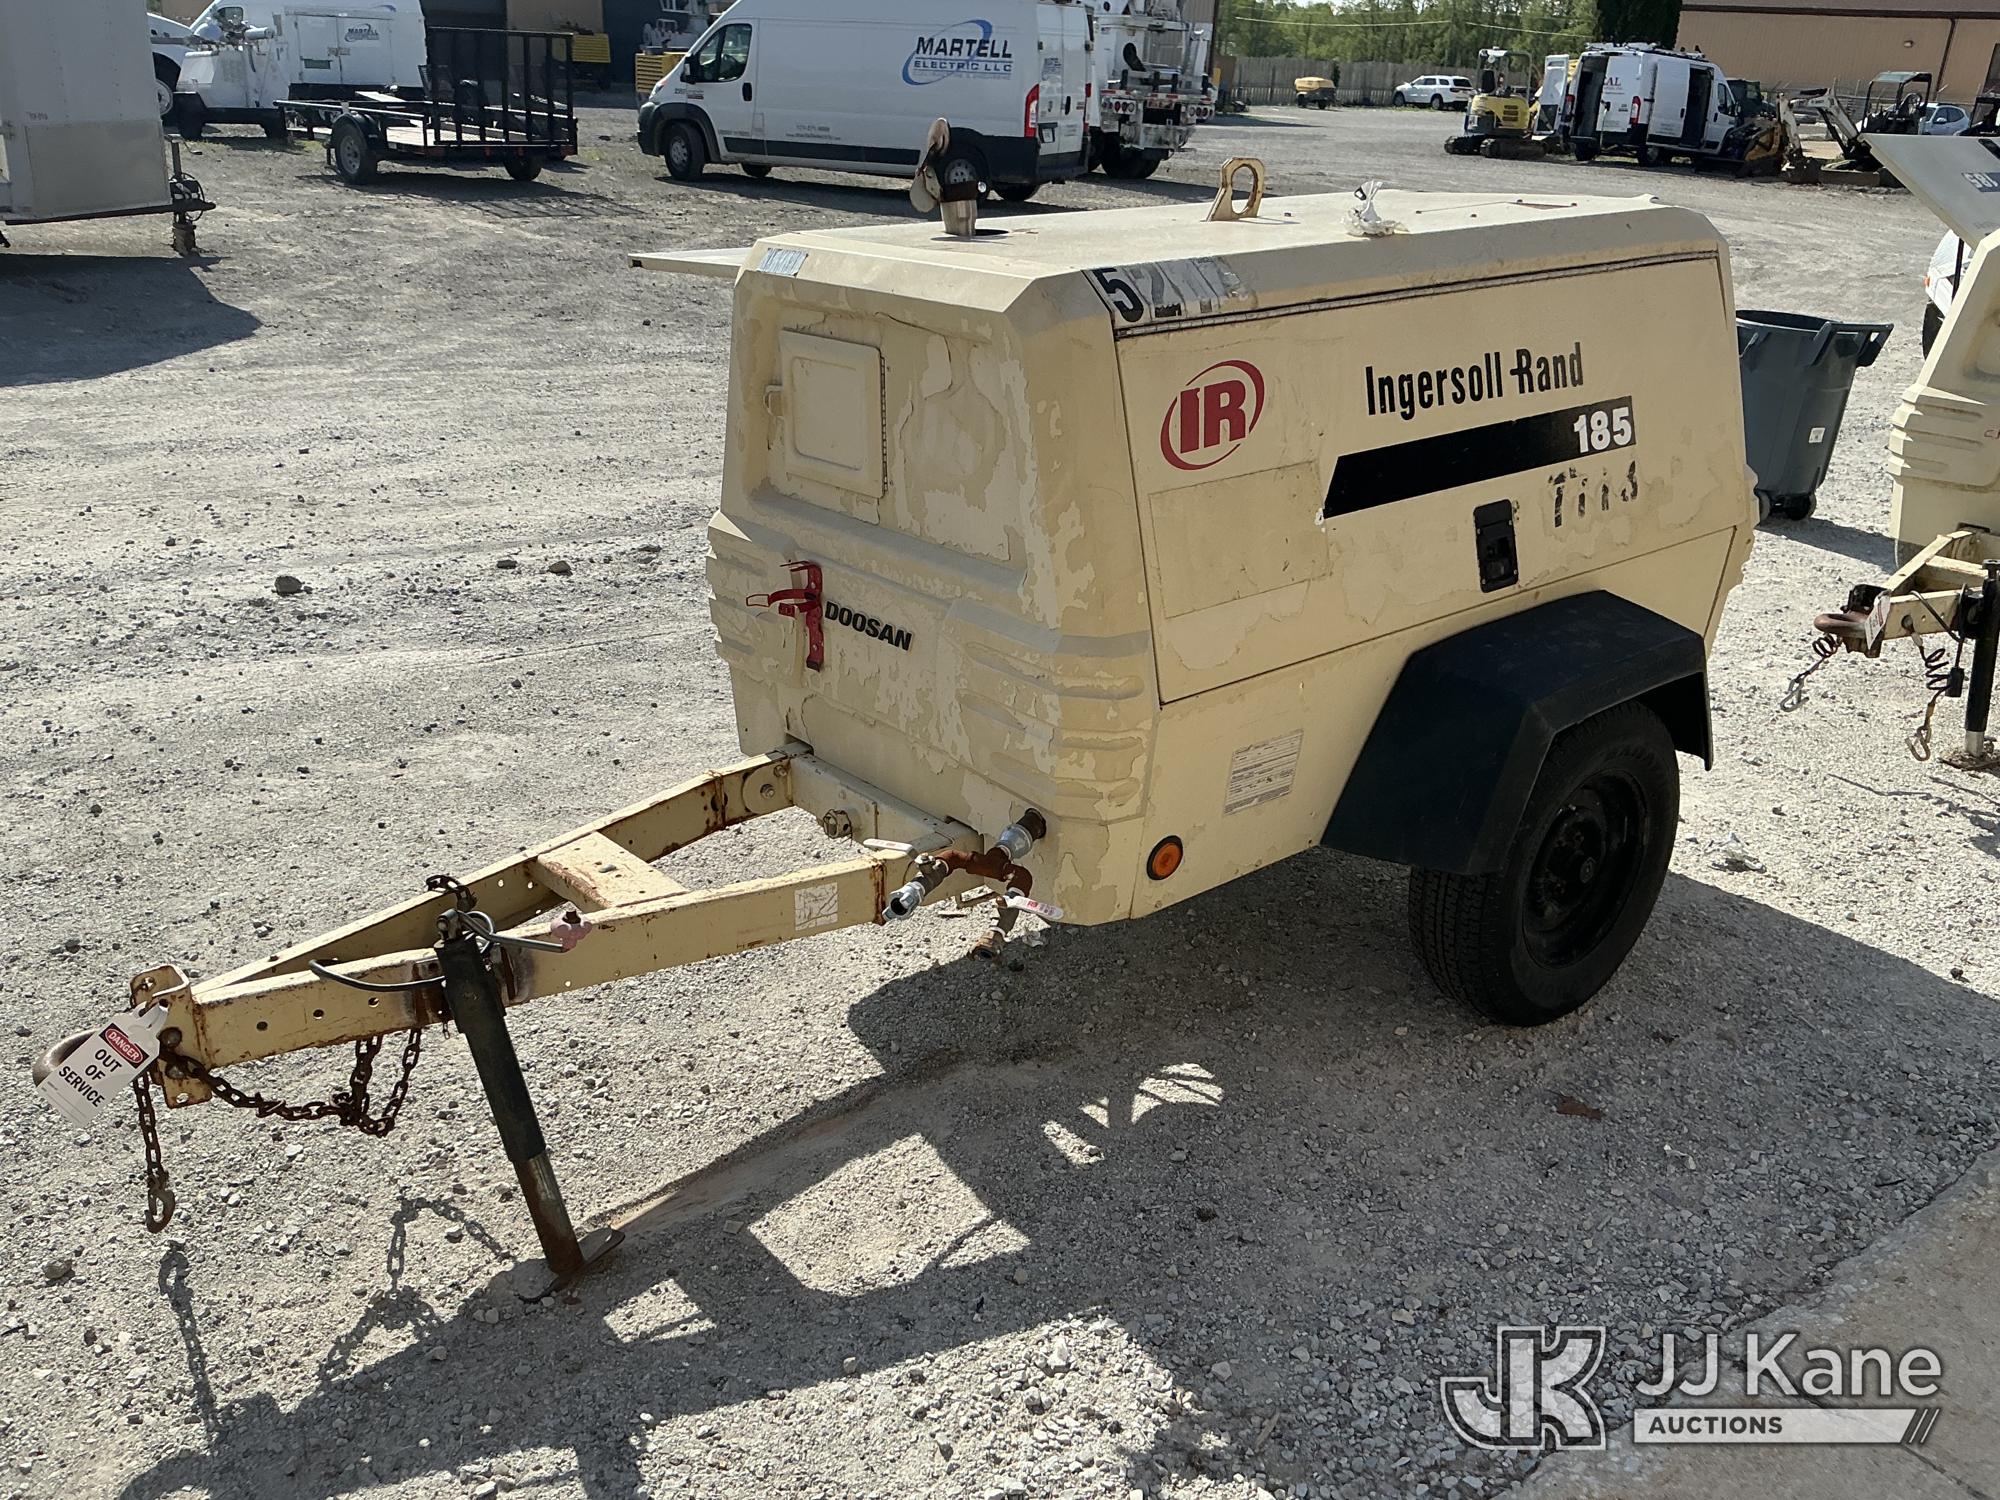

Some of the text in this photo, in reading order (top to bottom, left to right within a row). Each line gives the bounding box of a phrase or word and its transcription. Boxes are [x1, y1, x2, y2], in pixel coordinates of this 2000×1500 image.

[915, 36, 1013, 59] MARTELL
[914, 60, 1013, 72] ELECTRIC LLC
[1179, 379, 1247, 454] IR
[1573, 406, 1633, 454] 185
[824, 601, 913, 651] DOOSAN
[94, 1049, 122, 1073] OUT
[108, 1031, 140, 1061] DANGER
[59, 1066, 105, 1108] SERVICE
[85, 1064, 106, 1081] OF
